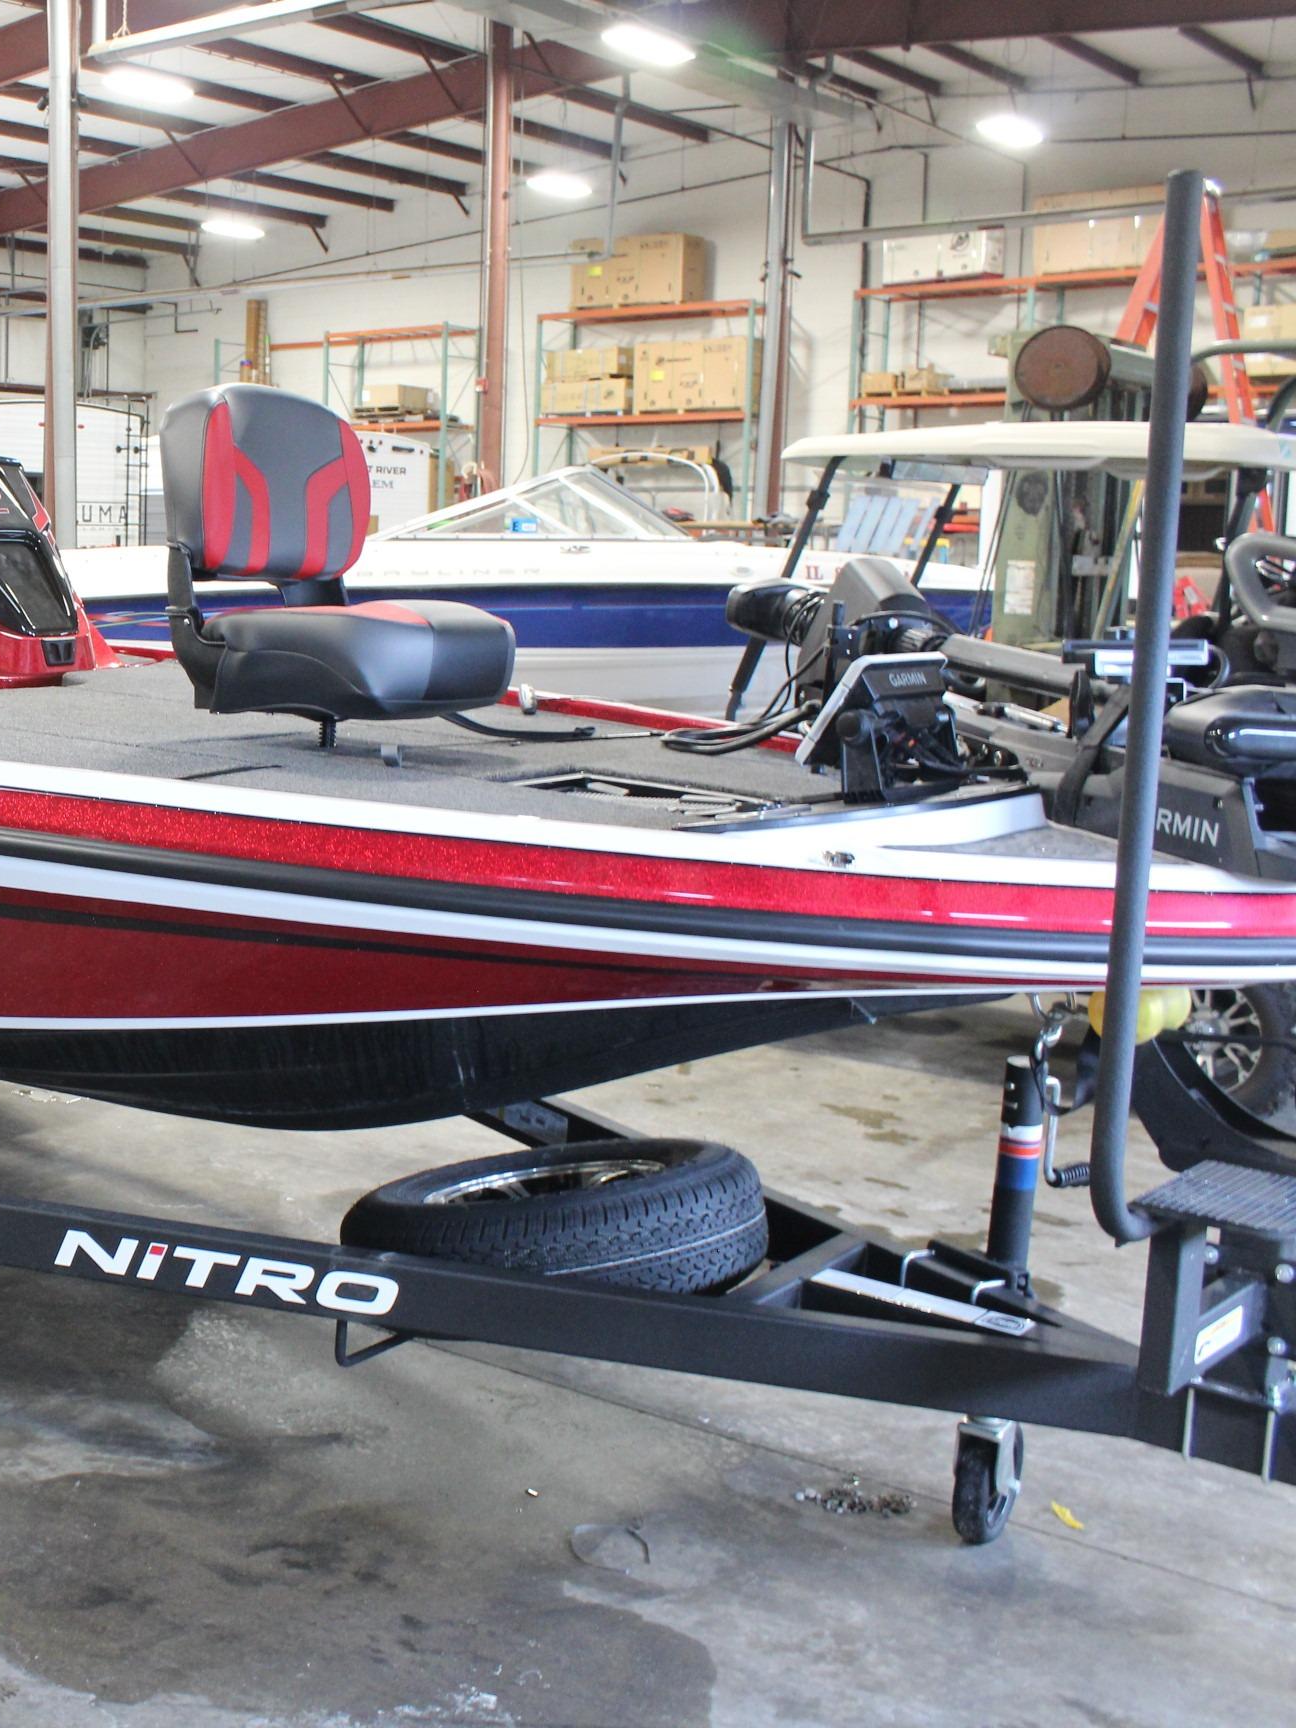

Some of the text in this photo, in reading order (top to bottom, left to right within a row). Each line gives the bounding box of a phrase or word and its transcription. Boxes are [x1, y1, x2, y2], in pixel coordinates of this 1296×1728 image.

[376, 465, 407, 475] RIVER
[372, 480, 394, 489] EM
[81, 505, 128, 524] UMA
[888, 671, 928, 688] GARMIN
[1156, 807, 1220, 848] RMIN
[54, 1229, 400, 1316] NITRO
